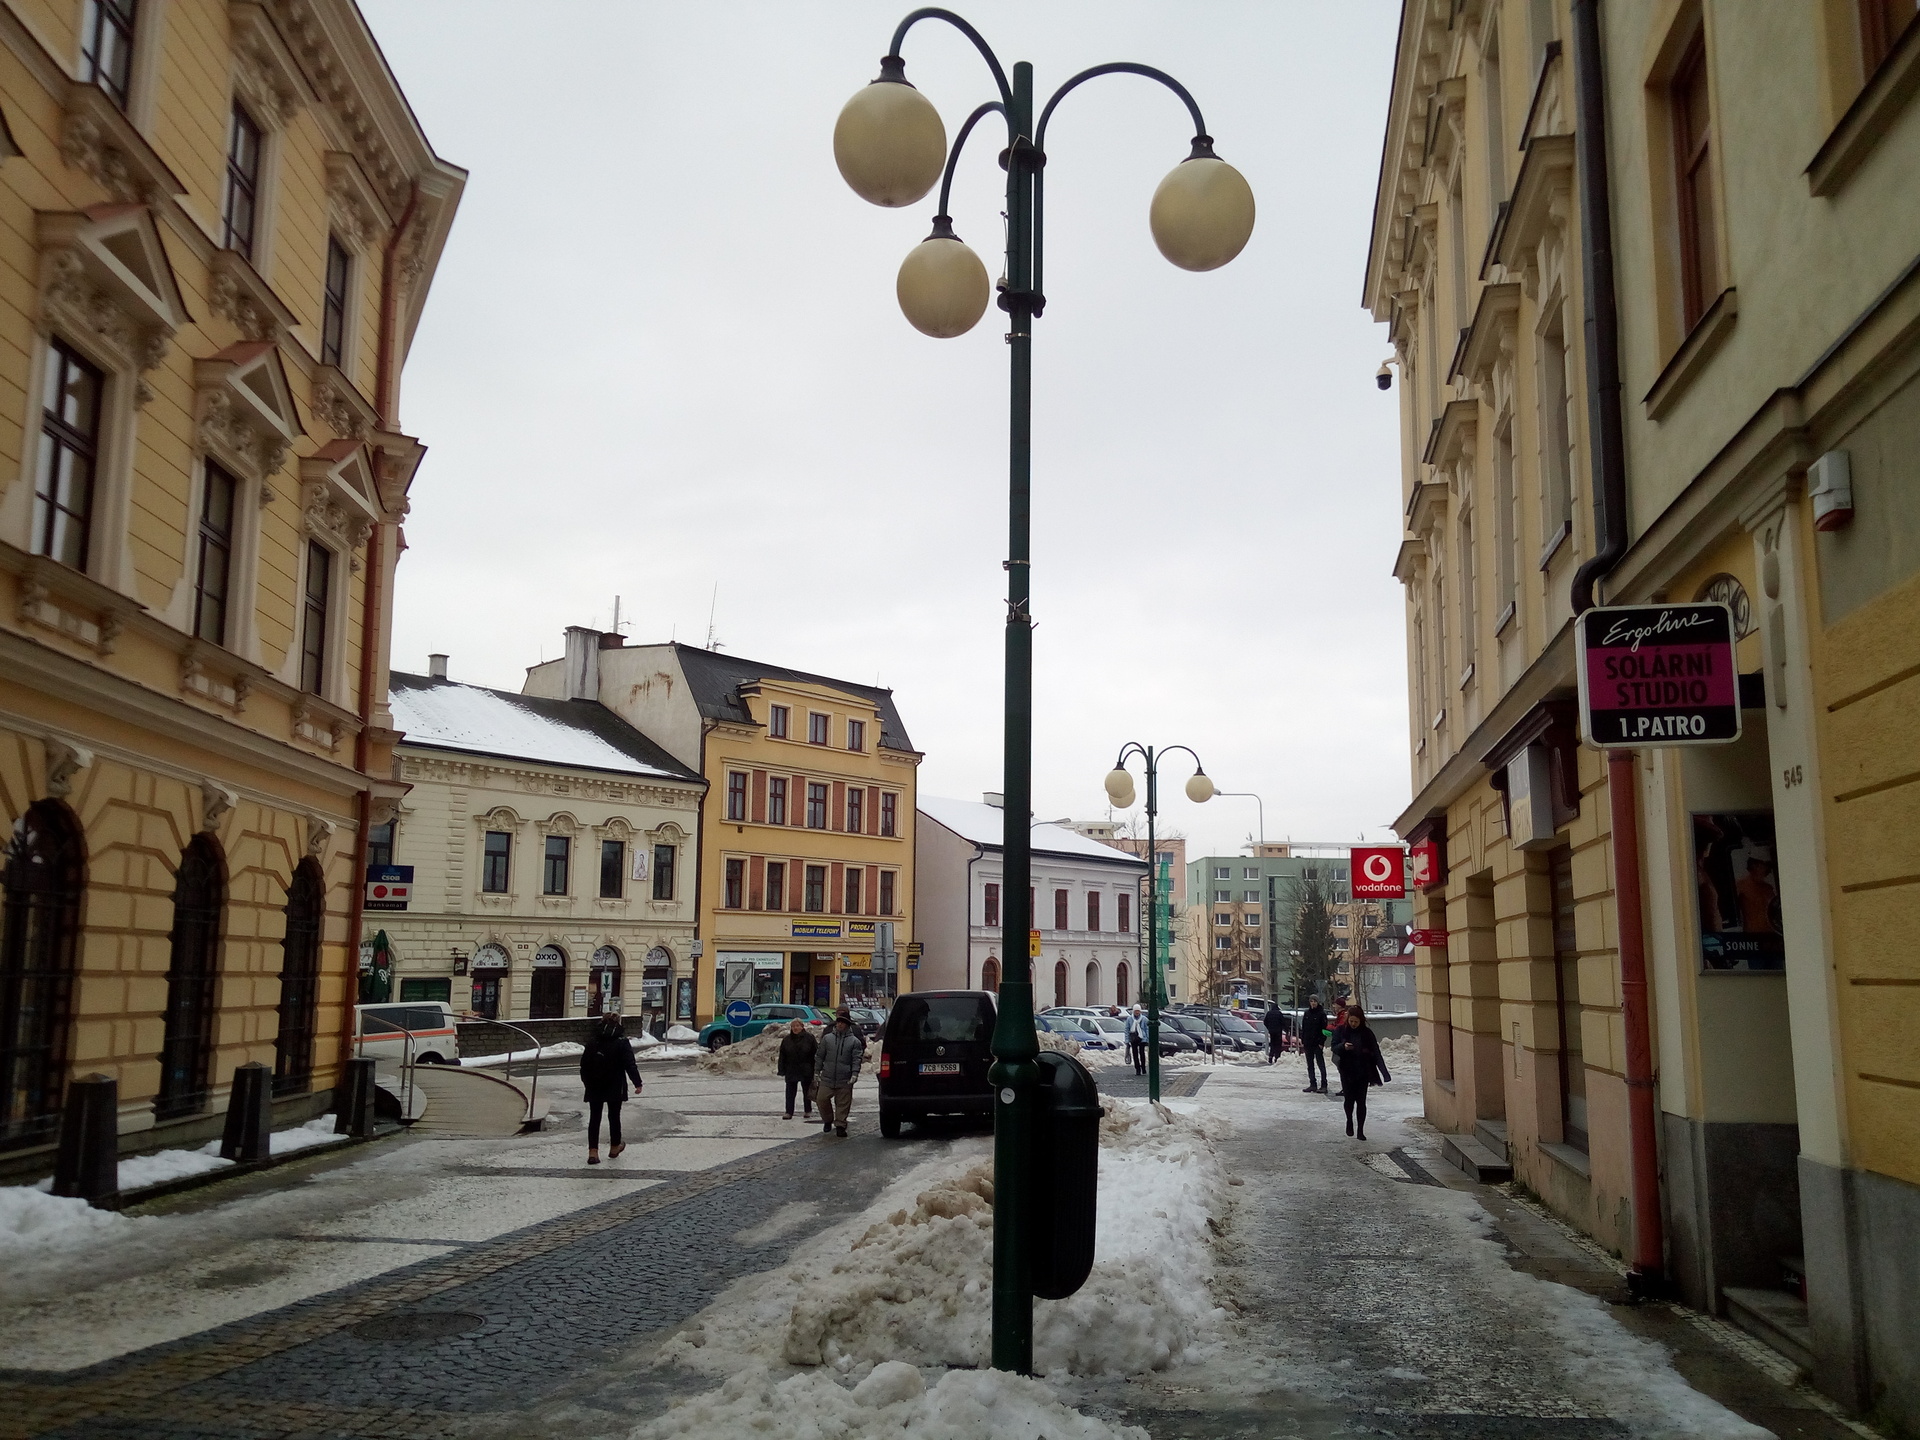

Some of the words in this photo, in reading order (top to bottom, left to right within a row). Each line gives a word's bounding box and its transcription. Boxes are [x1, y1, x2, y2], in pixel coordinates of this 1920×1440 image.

[1602, 610, 1714, 653] Ergoline
[1604, 646, 1713, 680] SOLÁRNÍ
[1616, 679, 1708, 707] STUDIO
[1783, 764, 1803, 789] 545
[1355, 883, 1402, 892] vodafone
[535, 953, 558, 961] OXXO
[1725, 941, 1759, 951] SONNE
